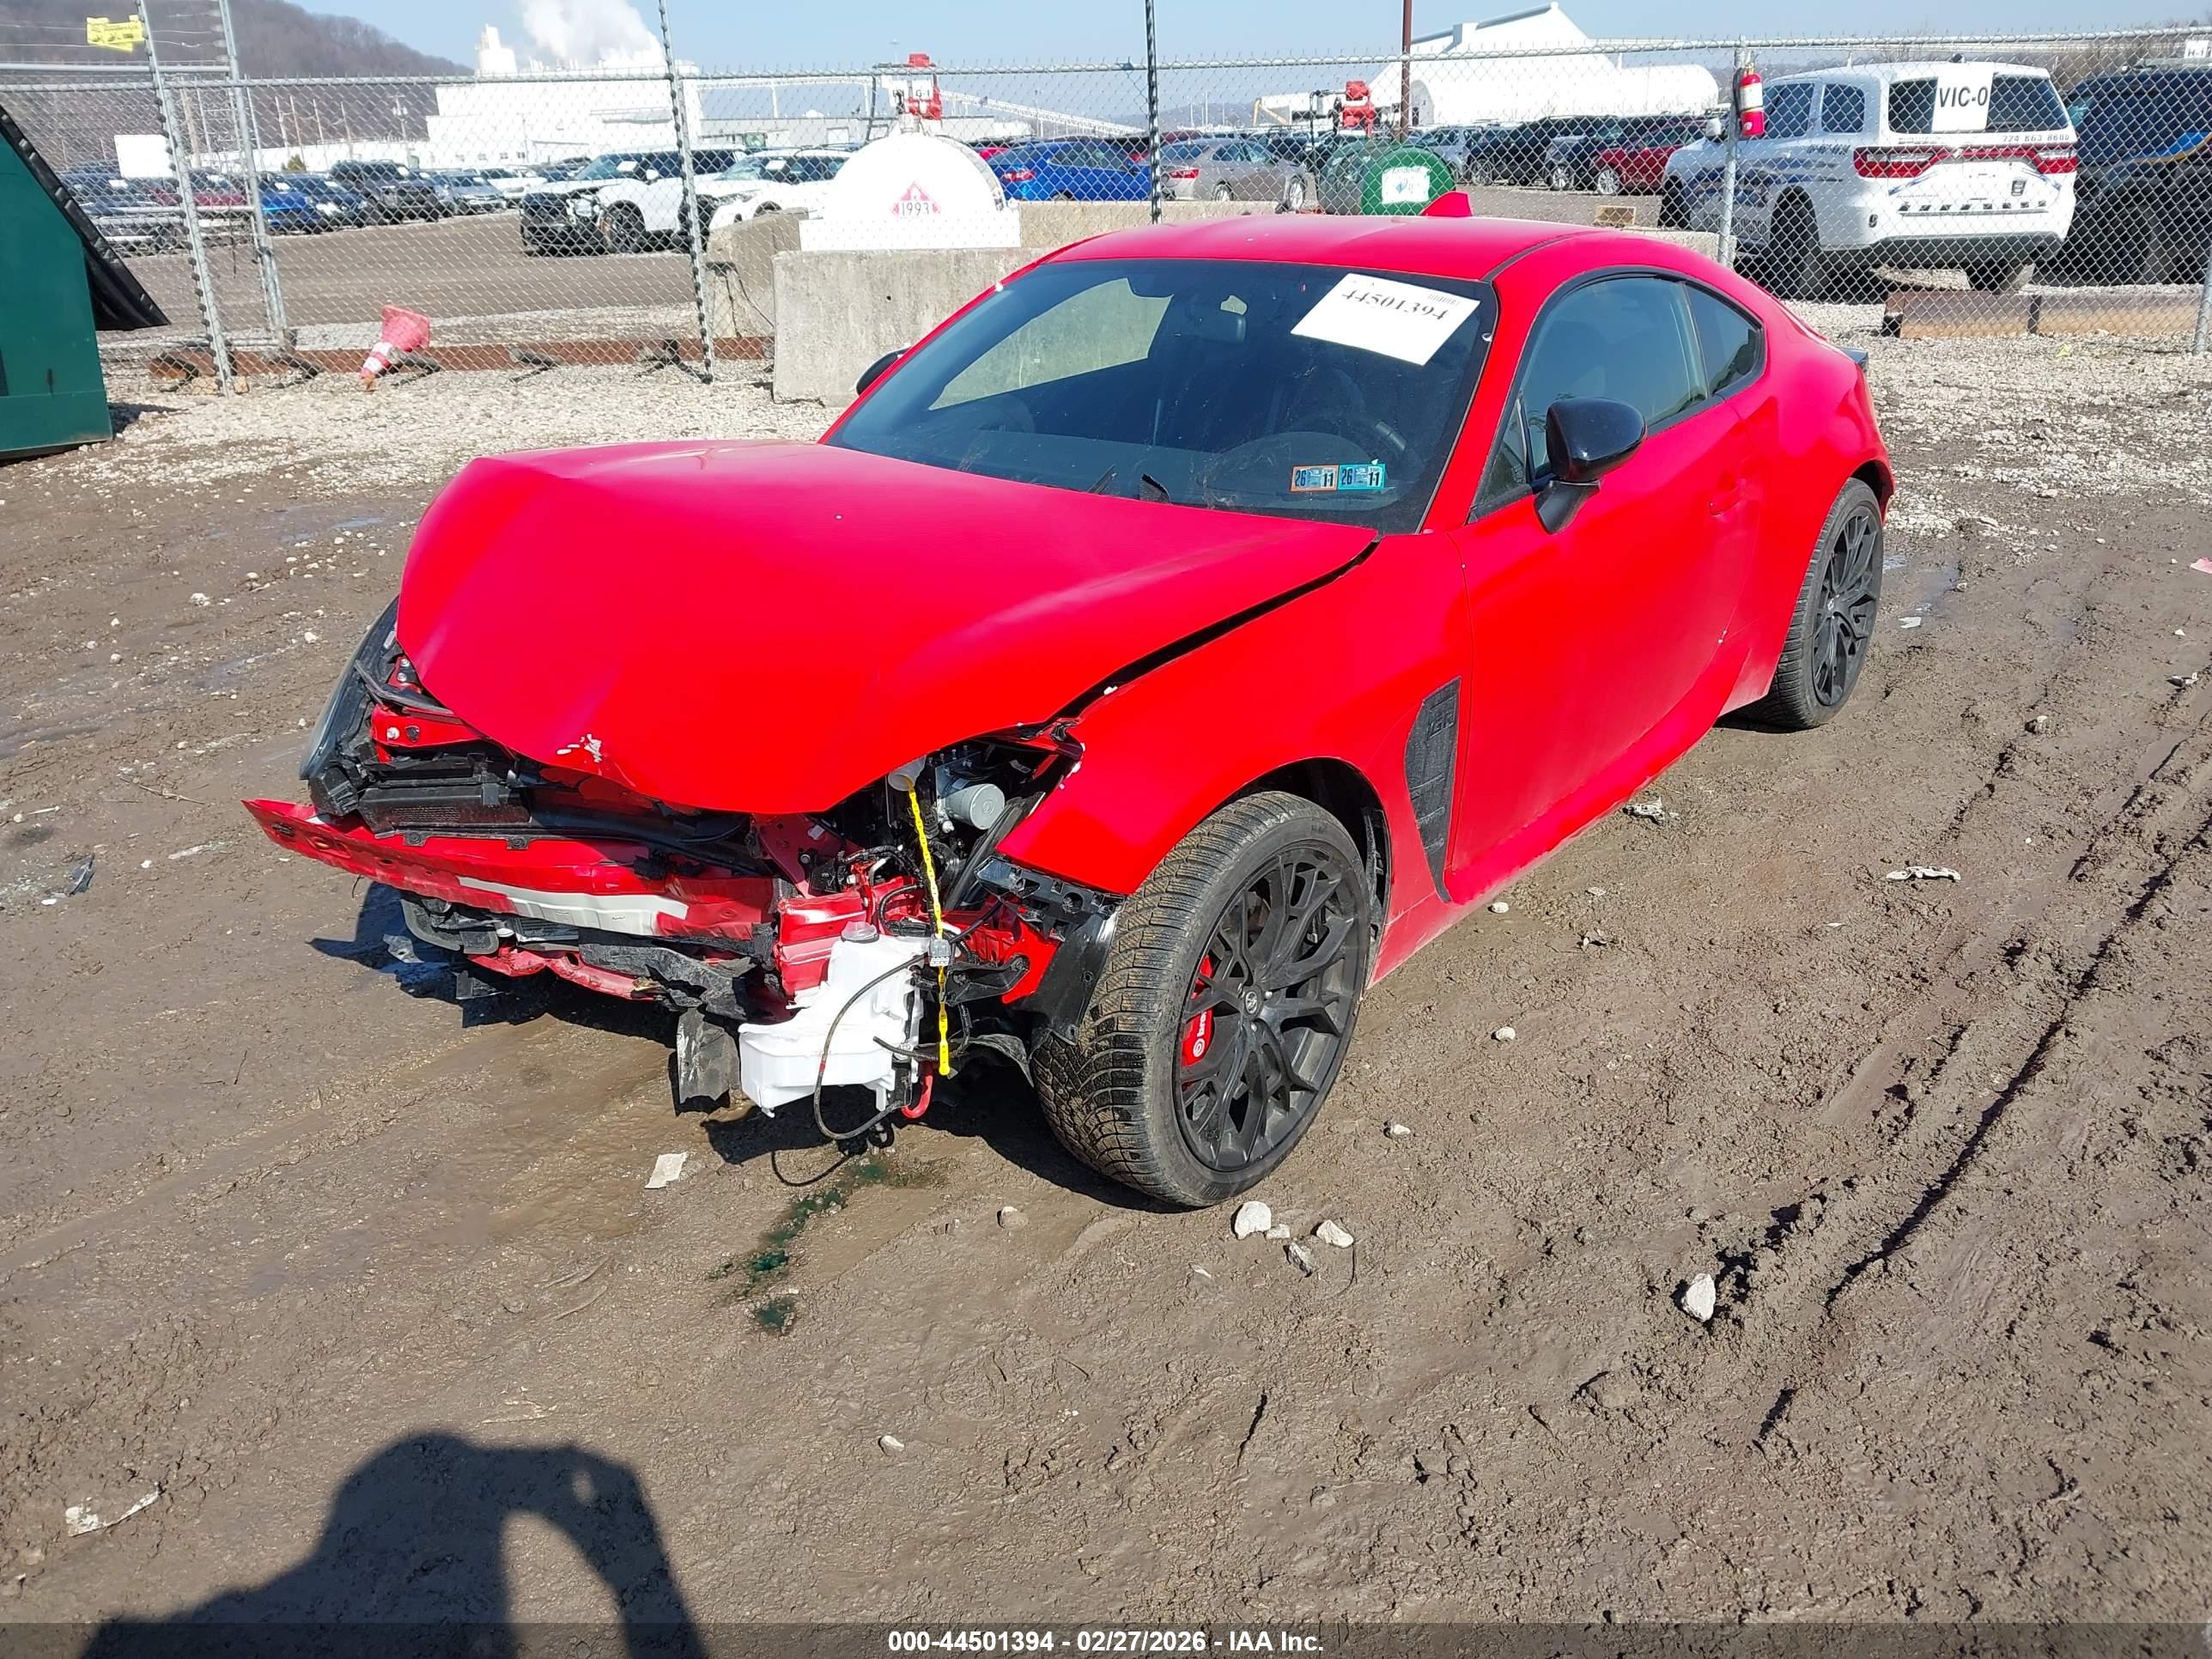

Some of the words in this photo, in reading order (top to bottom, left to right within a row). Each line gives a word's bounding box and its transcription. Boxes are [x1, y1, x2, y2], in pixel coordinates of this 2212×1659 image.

[1939, 85, 1989, 108] VIC-0
[901, 202, 930, 216] 1993
[1341, 289, 1449, 320] 44501394
[1295, 470, 1307, 487] 26
[1341, 468, 1353, 485] 26
